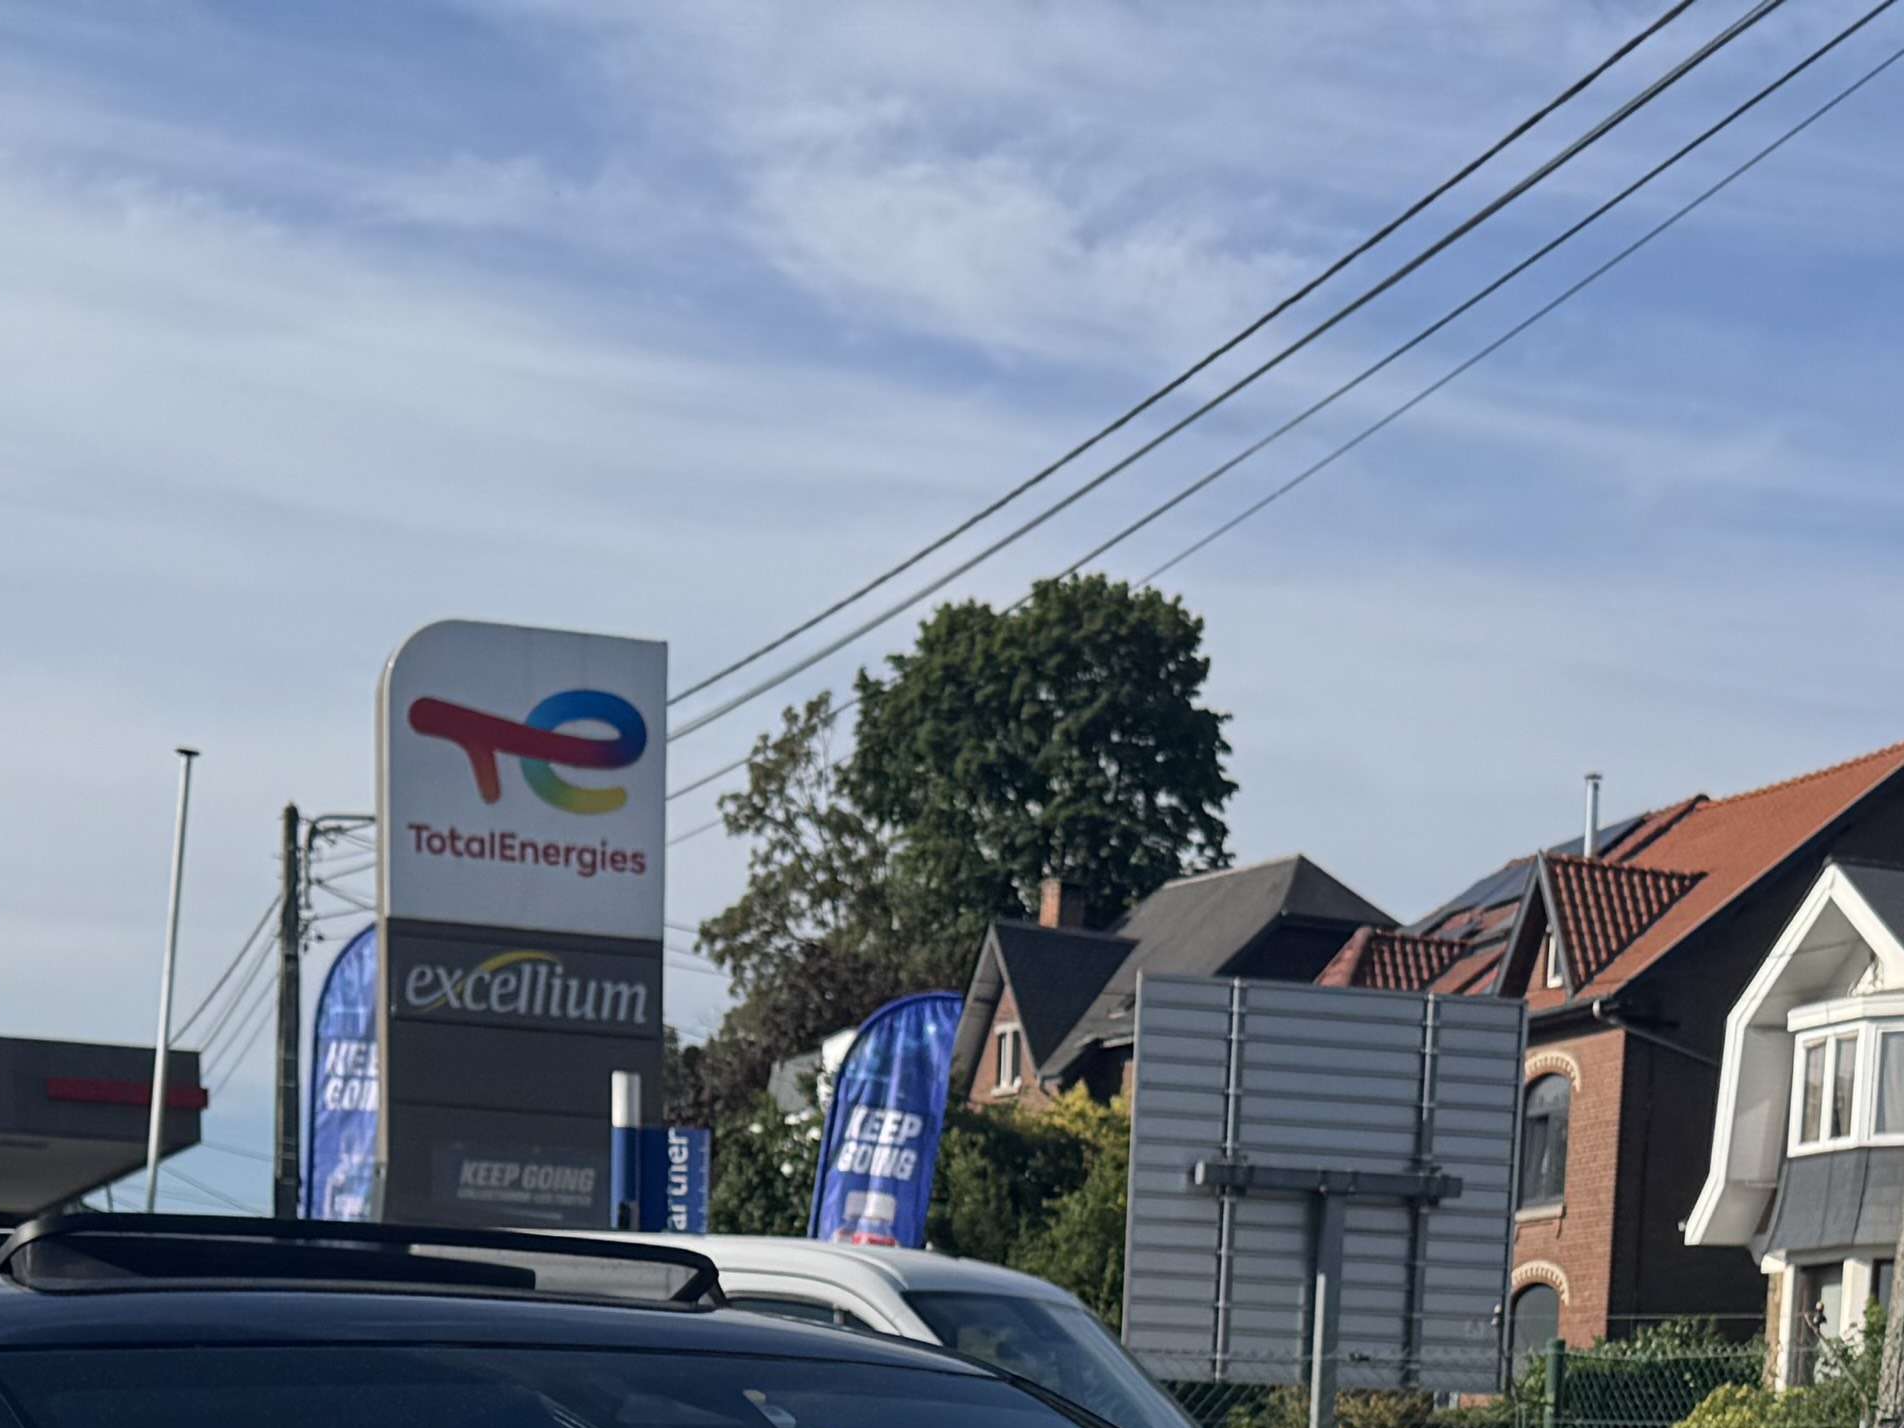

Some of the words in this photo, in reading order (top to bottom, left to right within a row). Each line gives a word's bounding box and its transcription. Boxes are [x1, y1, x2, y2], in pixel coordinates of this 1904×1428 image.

[407, 822, 647, 878] TotalEnergies
[404, 961, 649, 1024] excellium
[845, 1104, 924, 1147] KEEP
[458, 1159, 521, 1188] KEEP
[521, 1163, 596, 1194] GOING
[667, 1126, 689, 1231] artner
[837, 1141, 918, 1181] GOING
